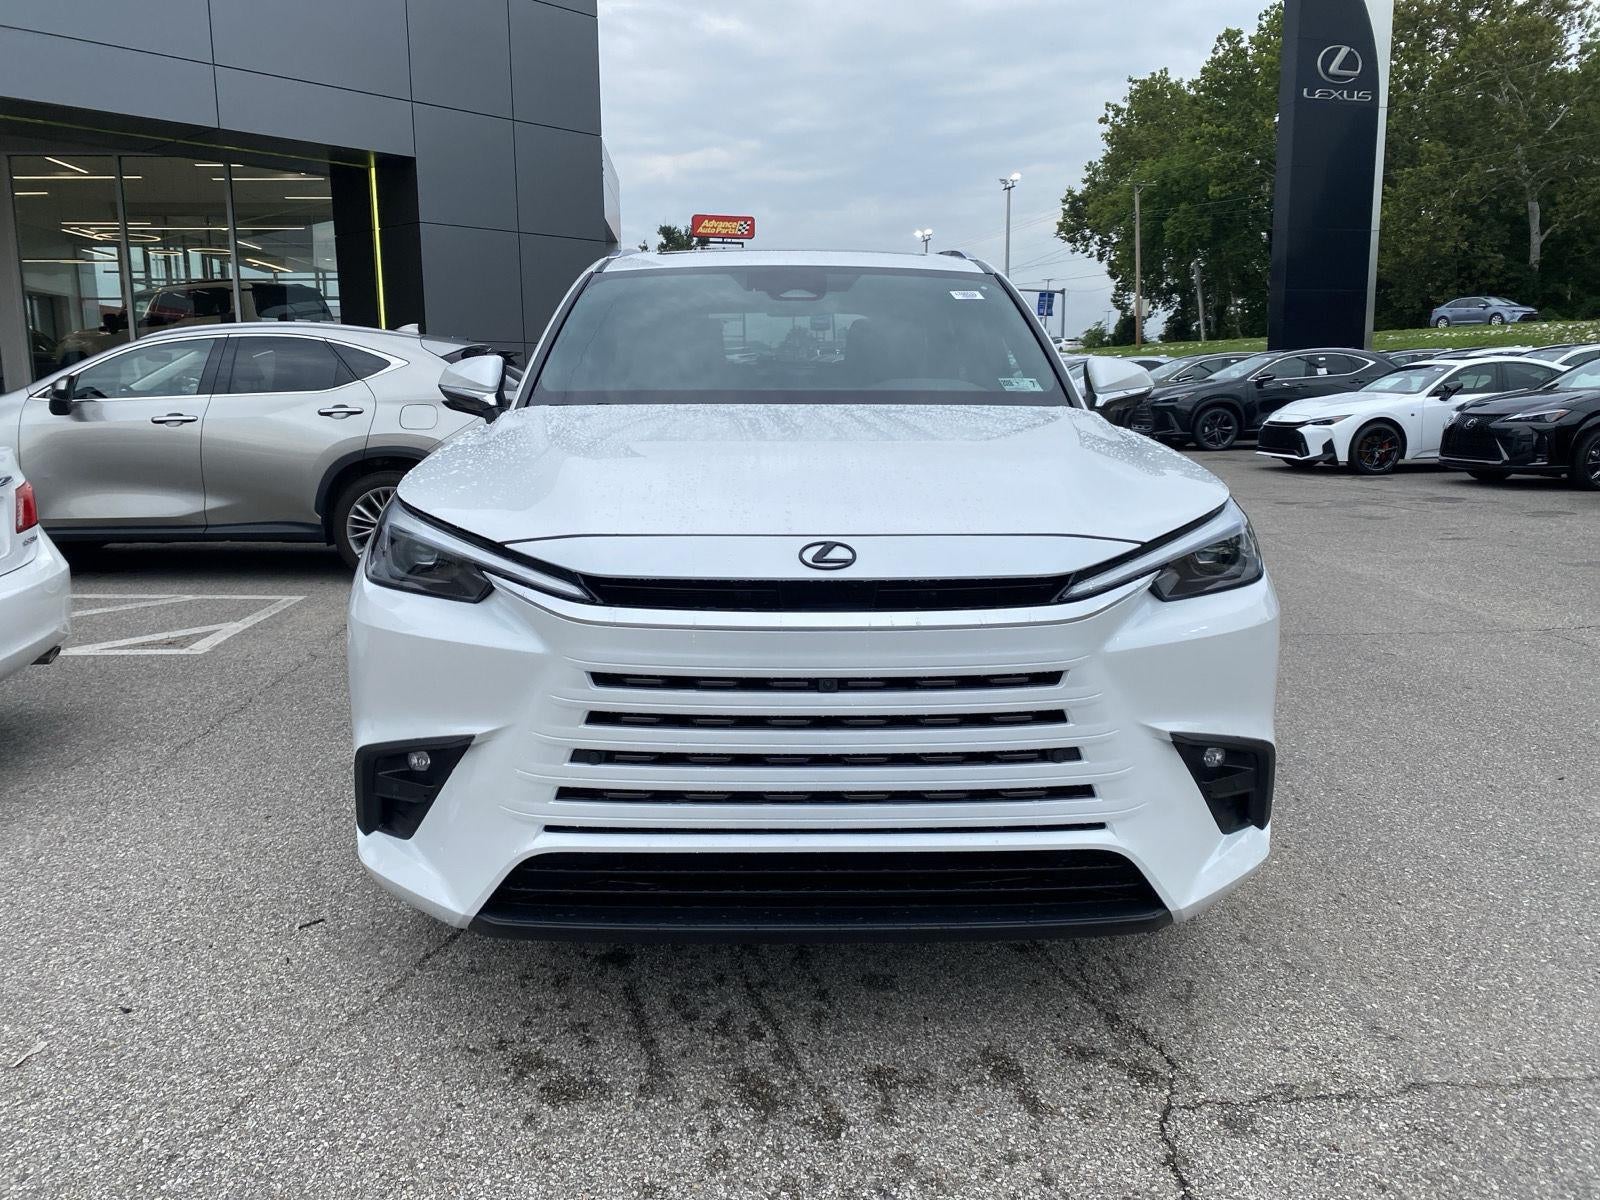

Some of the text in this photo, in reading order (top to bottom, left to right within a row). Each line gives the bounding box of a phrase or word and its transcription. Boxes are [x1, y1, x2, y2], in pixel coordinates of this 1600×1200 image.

[1303, 87, 1372, 102] LEXUS
[701, 219, 738, 228] Advance
[697, 226, 716, 234] Auto
